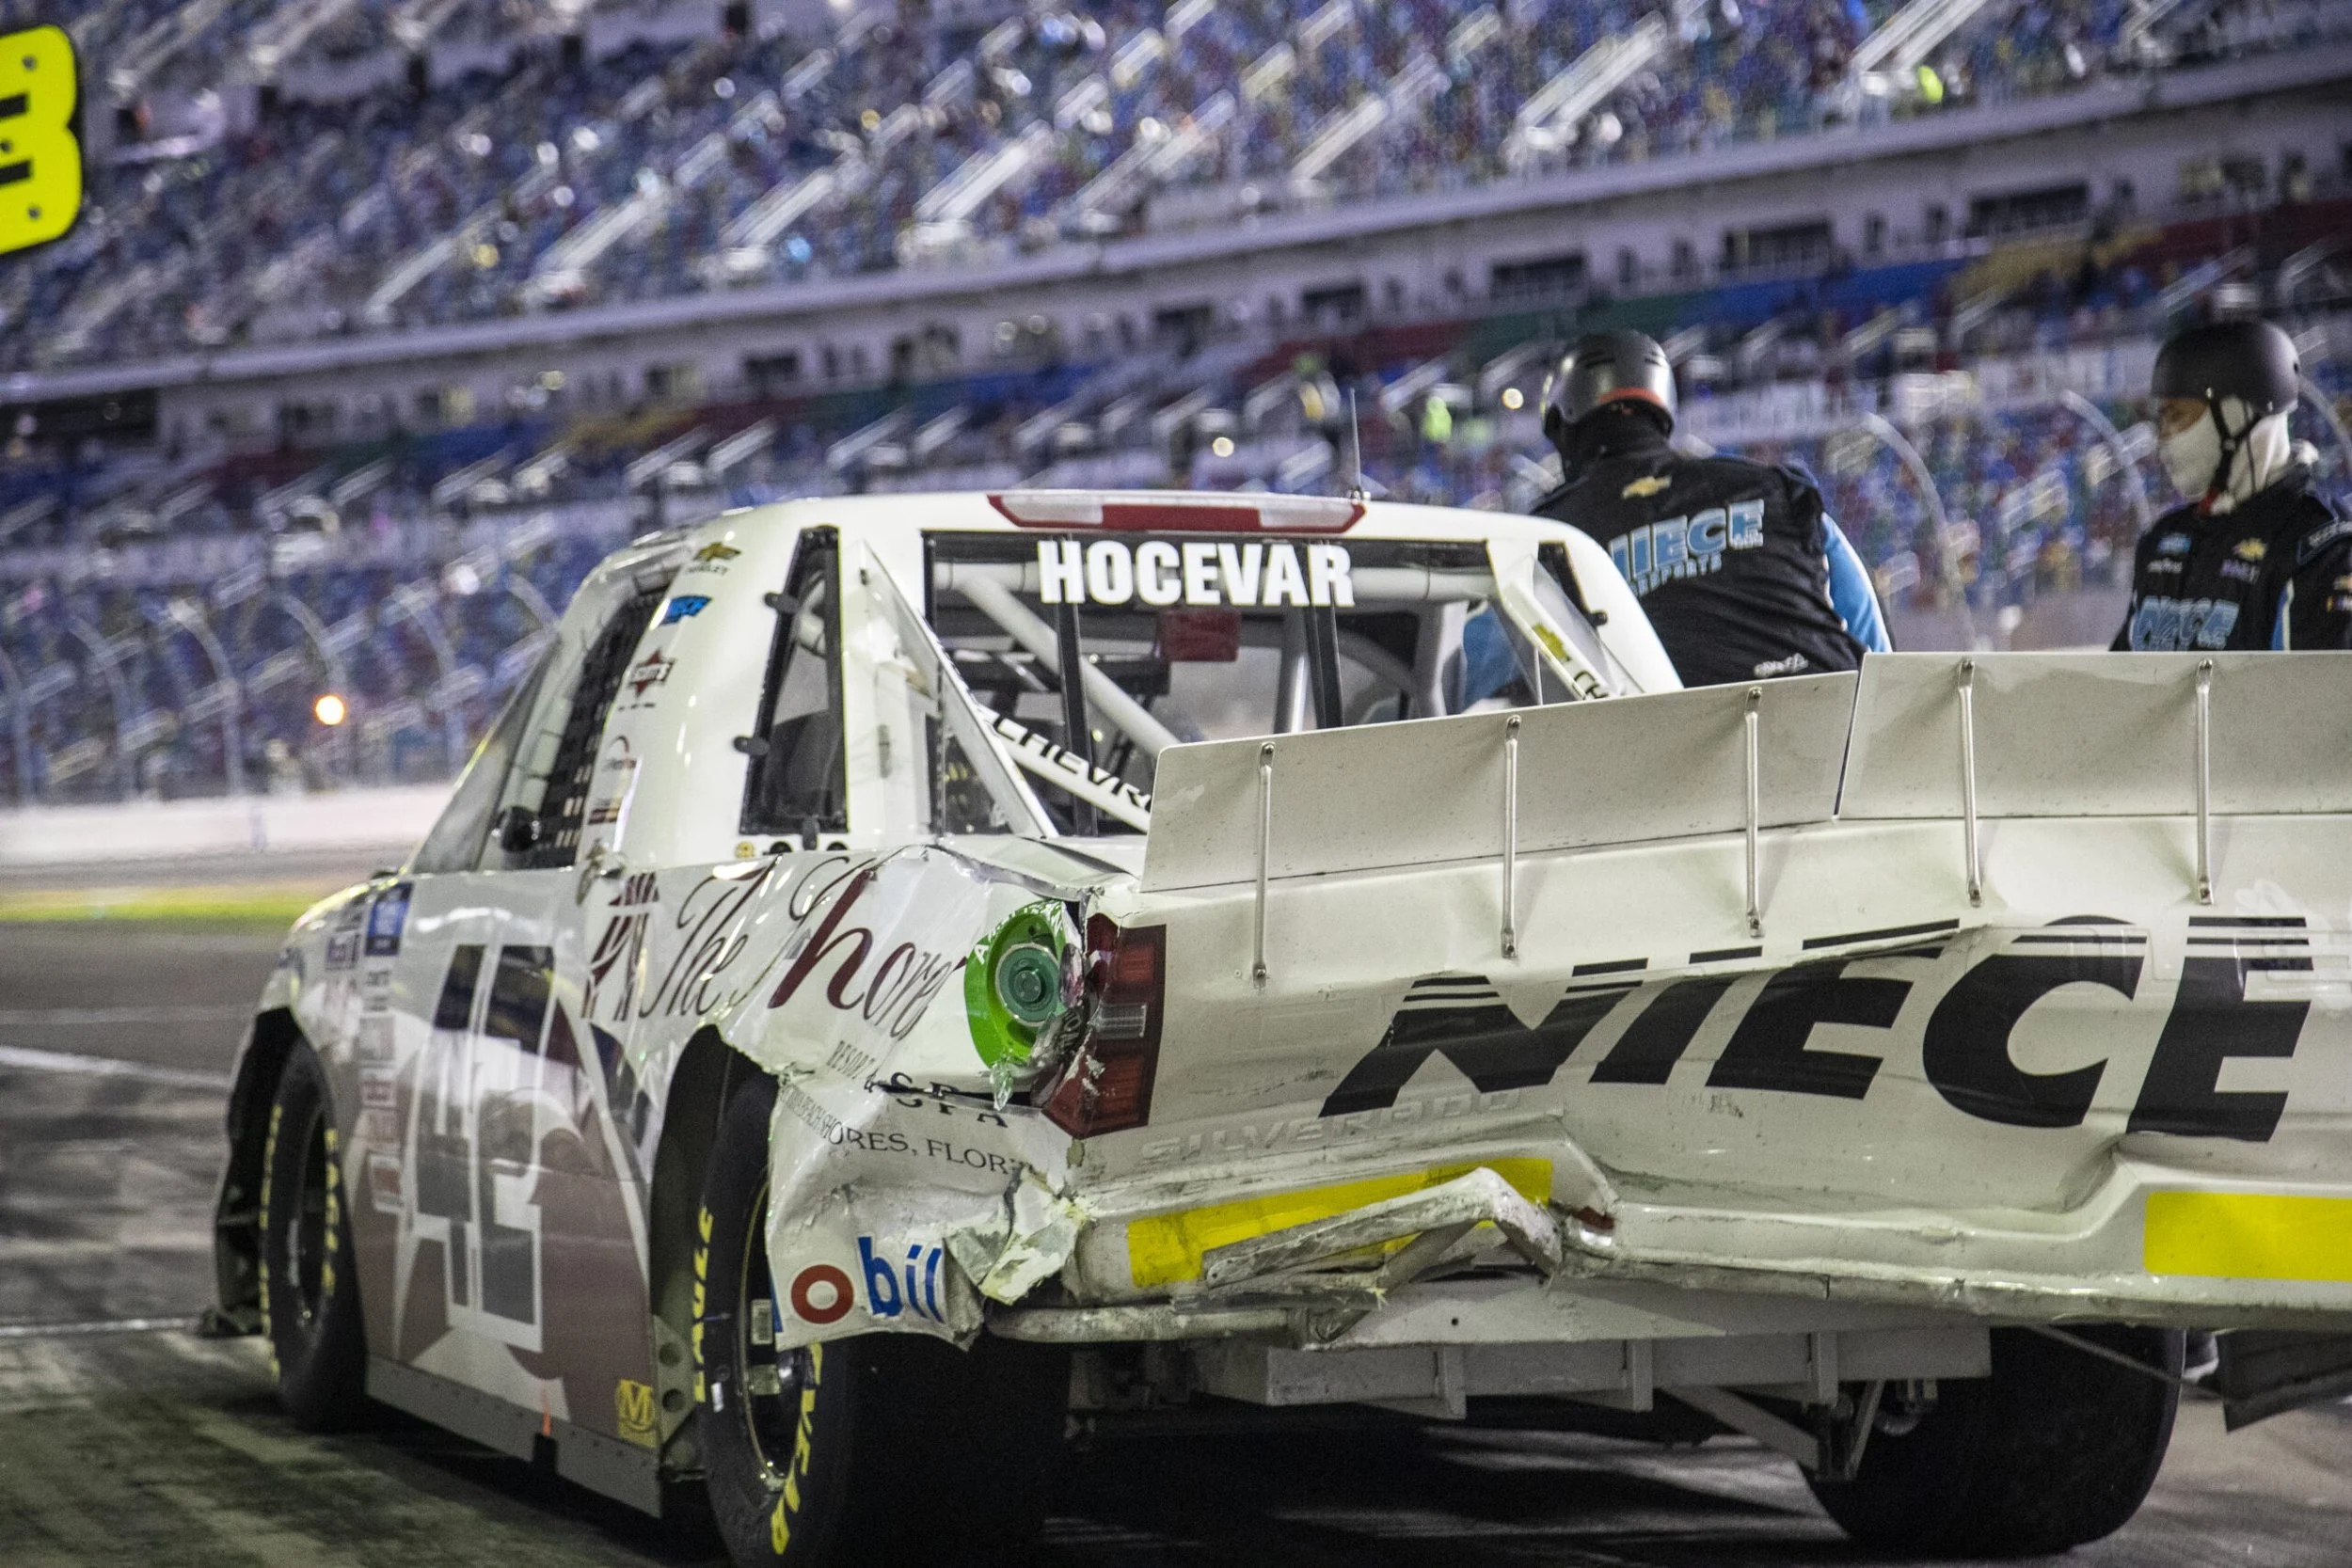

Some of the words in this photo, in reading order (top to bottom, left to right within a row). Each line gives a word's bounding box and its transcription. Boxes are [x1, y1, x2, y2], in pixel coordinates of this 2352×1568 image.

[1038, 539, 1355, 607] HOCEVAR
[993, 715, 1152, 813] CHEVR
[1319, 914, 2314, 1143] NIECE
[771, 1235, 946, 1334] obil
